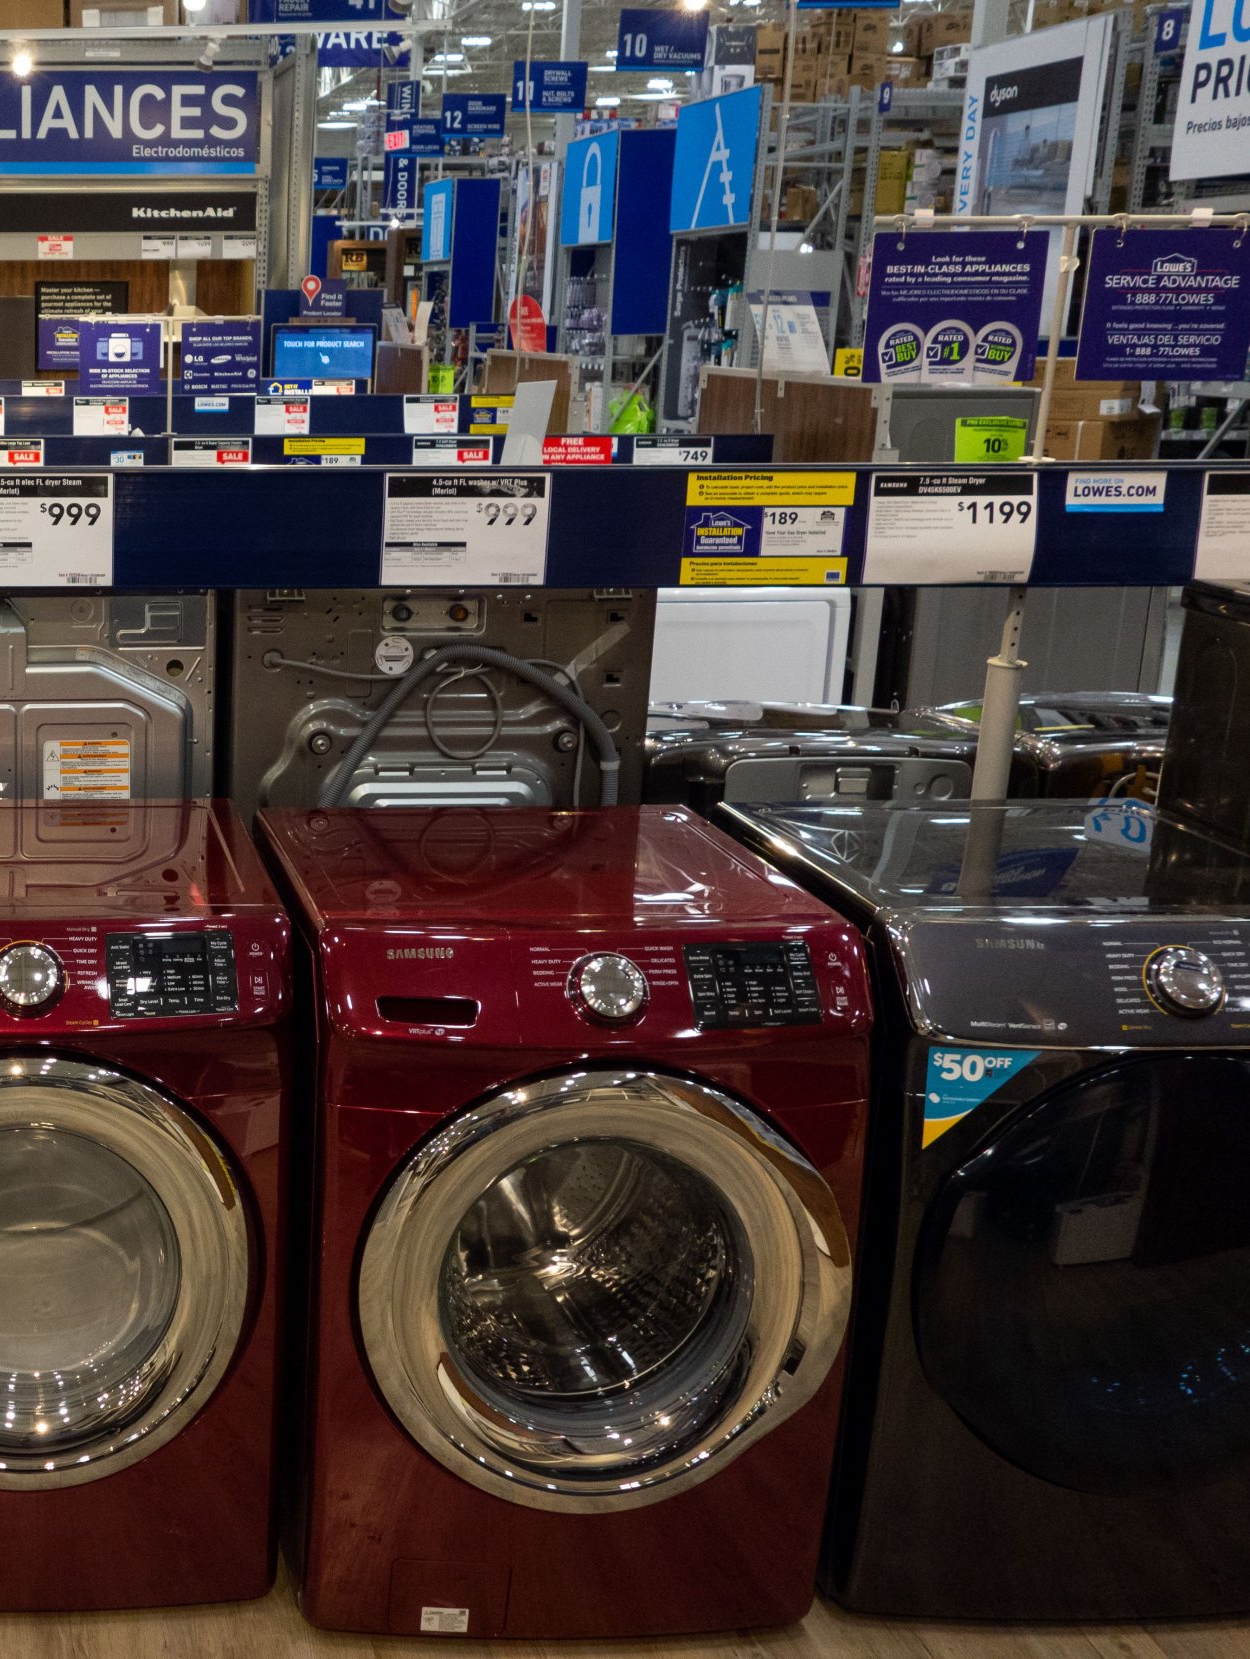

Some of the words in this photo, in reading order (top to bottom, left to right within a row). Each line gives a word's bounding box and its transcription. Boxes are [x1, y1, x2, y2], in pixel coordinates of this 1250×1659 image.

[279, 3, 309, 11] REPAIR
[1161, 20, 1174, 40] 8
[624, 33, 647, 57] 10
[1190, 54, 1250, 104] PRI
[516, 80, 535, 101] 11
[883, 87, 890, 104] 9
[990, 84, 1018, 107] dyson
[445, 111, 462, 128] 12
[965, 95, 978, 141] DAY
[1186, 118, 1222, 135] Precios
[132, 144, 245, 158] Electrodomésticos
[132, 206, 235, 219] KitchenAid
[886, 264, 962, 273] BEST-IN-CLASS
[964, 264, 1031, 273] APPLIANCES
[1156, 262, 1192, 272] LOWE'S
[1105, 276, 1157, 288] SERVICE
[1159, 276, 1240, 288] ADVANTAGE
[889, 335, 914, 346] RATED
[937, 334, 964, 342] RATED
[987, 335, 1013, 344] RATED
[1107, 335, 1155, 345] VENTAJAS
[1156, 335, 1175, 345] DEL
[1177, 335, 1221, 345] SERVICIO
[895, 342, 917, 352] BEST
[943, 342, 961, 360] #1
[897, 350, 917, 362] BUY
[989, 350, 1011, 362] BUY
[13, 453, 35, 461] SALE
[222, 452, 243, 460] SALE
[463, 451, 484, 459] SALE
[678, 450, 708, 462] $749
[432, 478, 452, 486] 4.5-cu
[453, 478, 458, 486] ft
[459, 478, 467, 486] FL
[468, 478, 491, 486] washer
[491, 478, 500, 486] w/
[500, 478, 513, 486] VRT
[514, 478, 528, 486] Plus
[432, 488, 457, 496] (Merlot)
[1073, 486, 1157, 497] LOWES.COM
[40, 502, 102, 526] $999
[476, 502, 537, 526] $999
[764, 512, 799, 525] $189
[958, 501, 1032, 524] $1199
[697, 528, 743, 536] INSTALLATION
[700, 536, 737, 544] Guaranteed
[975, 938, 1044, 950] SAMSUNG
[386, 948, 454, 960] SAMSUNG
[933, 1052, 985, 1082] $50
[985, 1057, 1013, 1070] OFF
